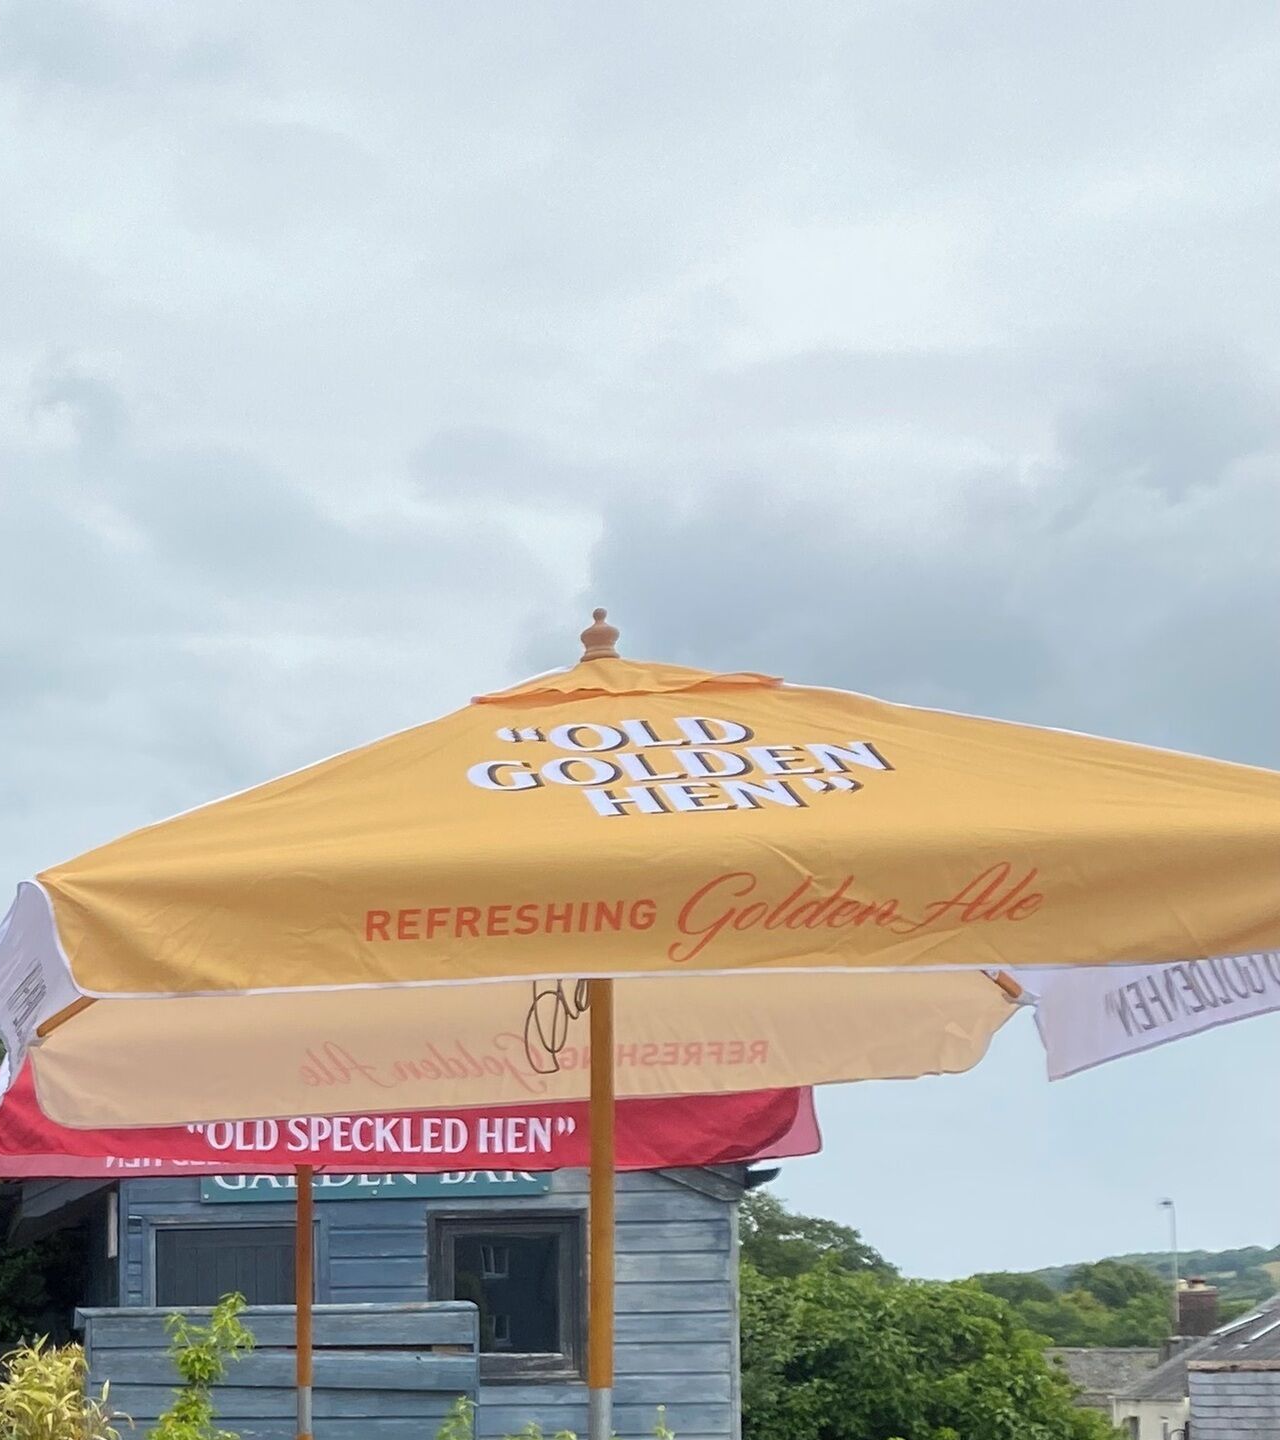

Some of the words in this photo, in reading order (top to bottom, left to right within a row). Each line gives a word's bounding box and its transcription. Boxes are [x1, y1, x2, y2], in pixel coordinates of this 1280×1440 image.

[496, 716, 755, 753] “OLD
[467, 741, 896, 791] GOLDEN
[582, 776, 864, 817] HEN”
[365, 896, 657, 942] REFRESHING
[668, 872, 898, 963] Golden
[892, 862, 1044, 933] Ale
[187, 1119, 279, 1152] “OLD
[287, 1117, 468, 1154] SPECKLED
[477, 1116, 577, 1154] HEN”
